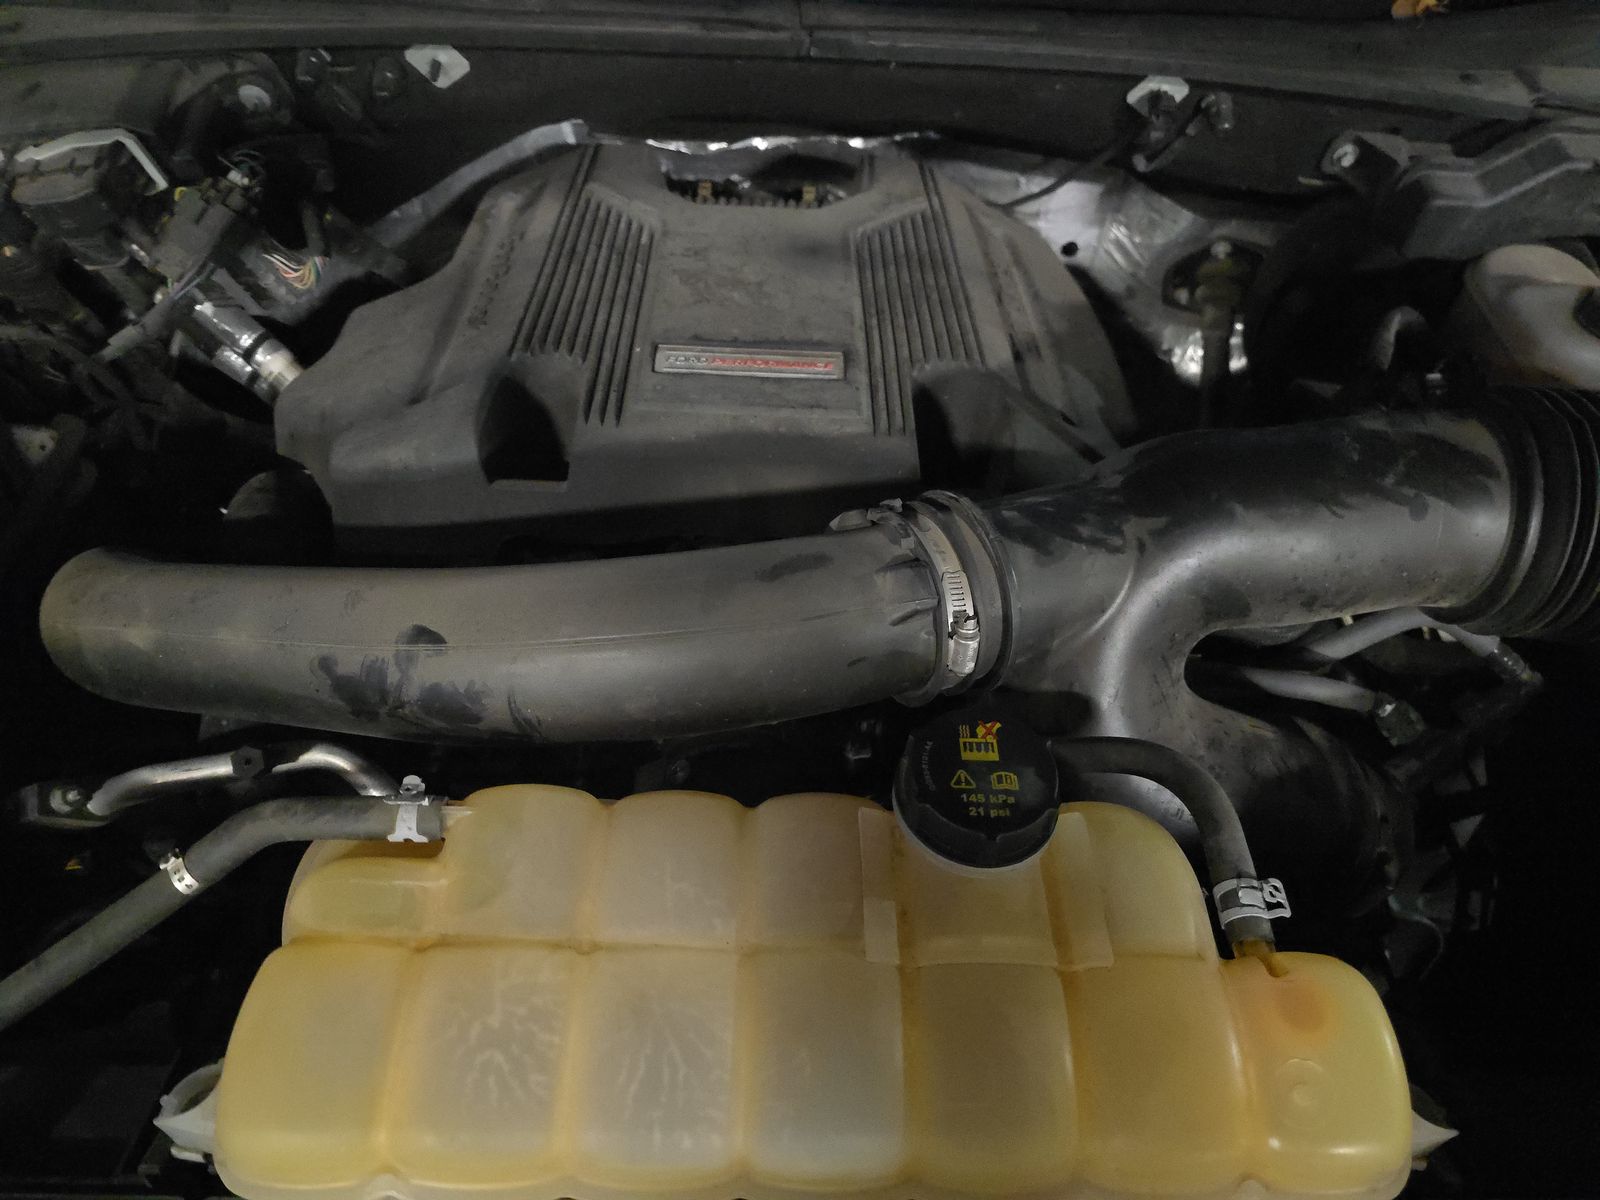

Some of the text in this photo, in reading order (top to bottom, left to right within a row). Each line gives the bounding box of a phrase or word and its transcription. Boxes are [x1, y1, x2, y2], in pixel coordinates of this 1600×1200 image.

[666, 355, 833, 371] FORD PERFORMANCE
[960, 793, 1016, 804] 145 kPa
[968, 806, 1010, 819] 21 psi
